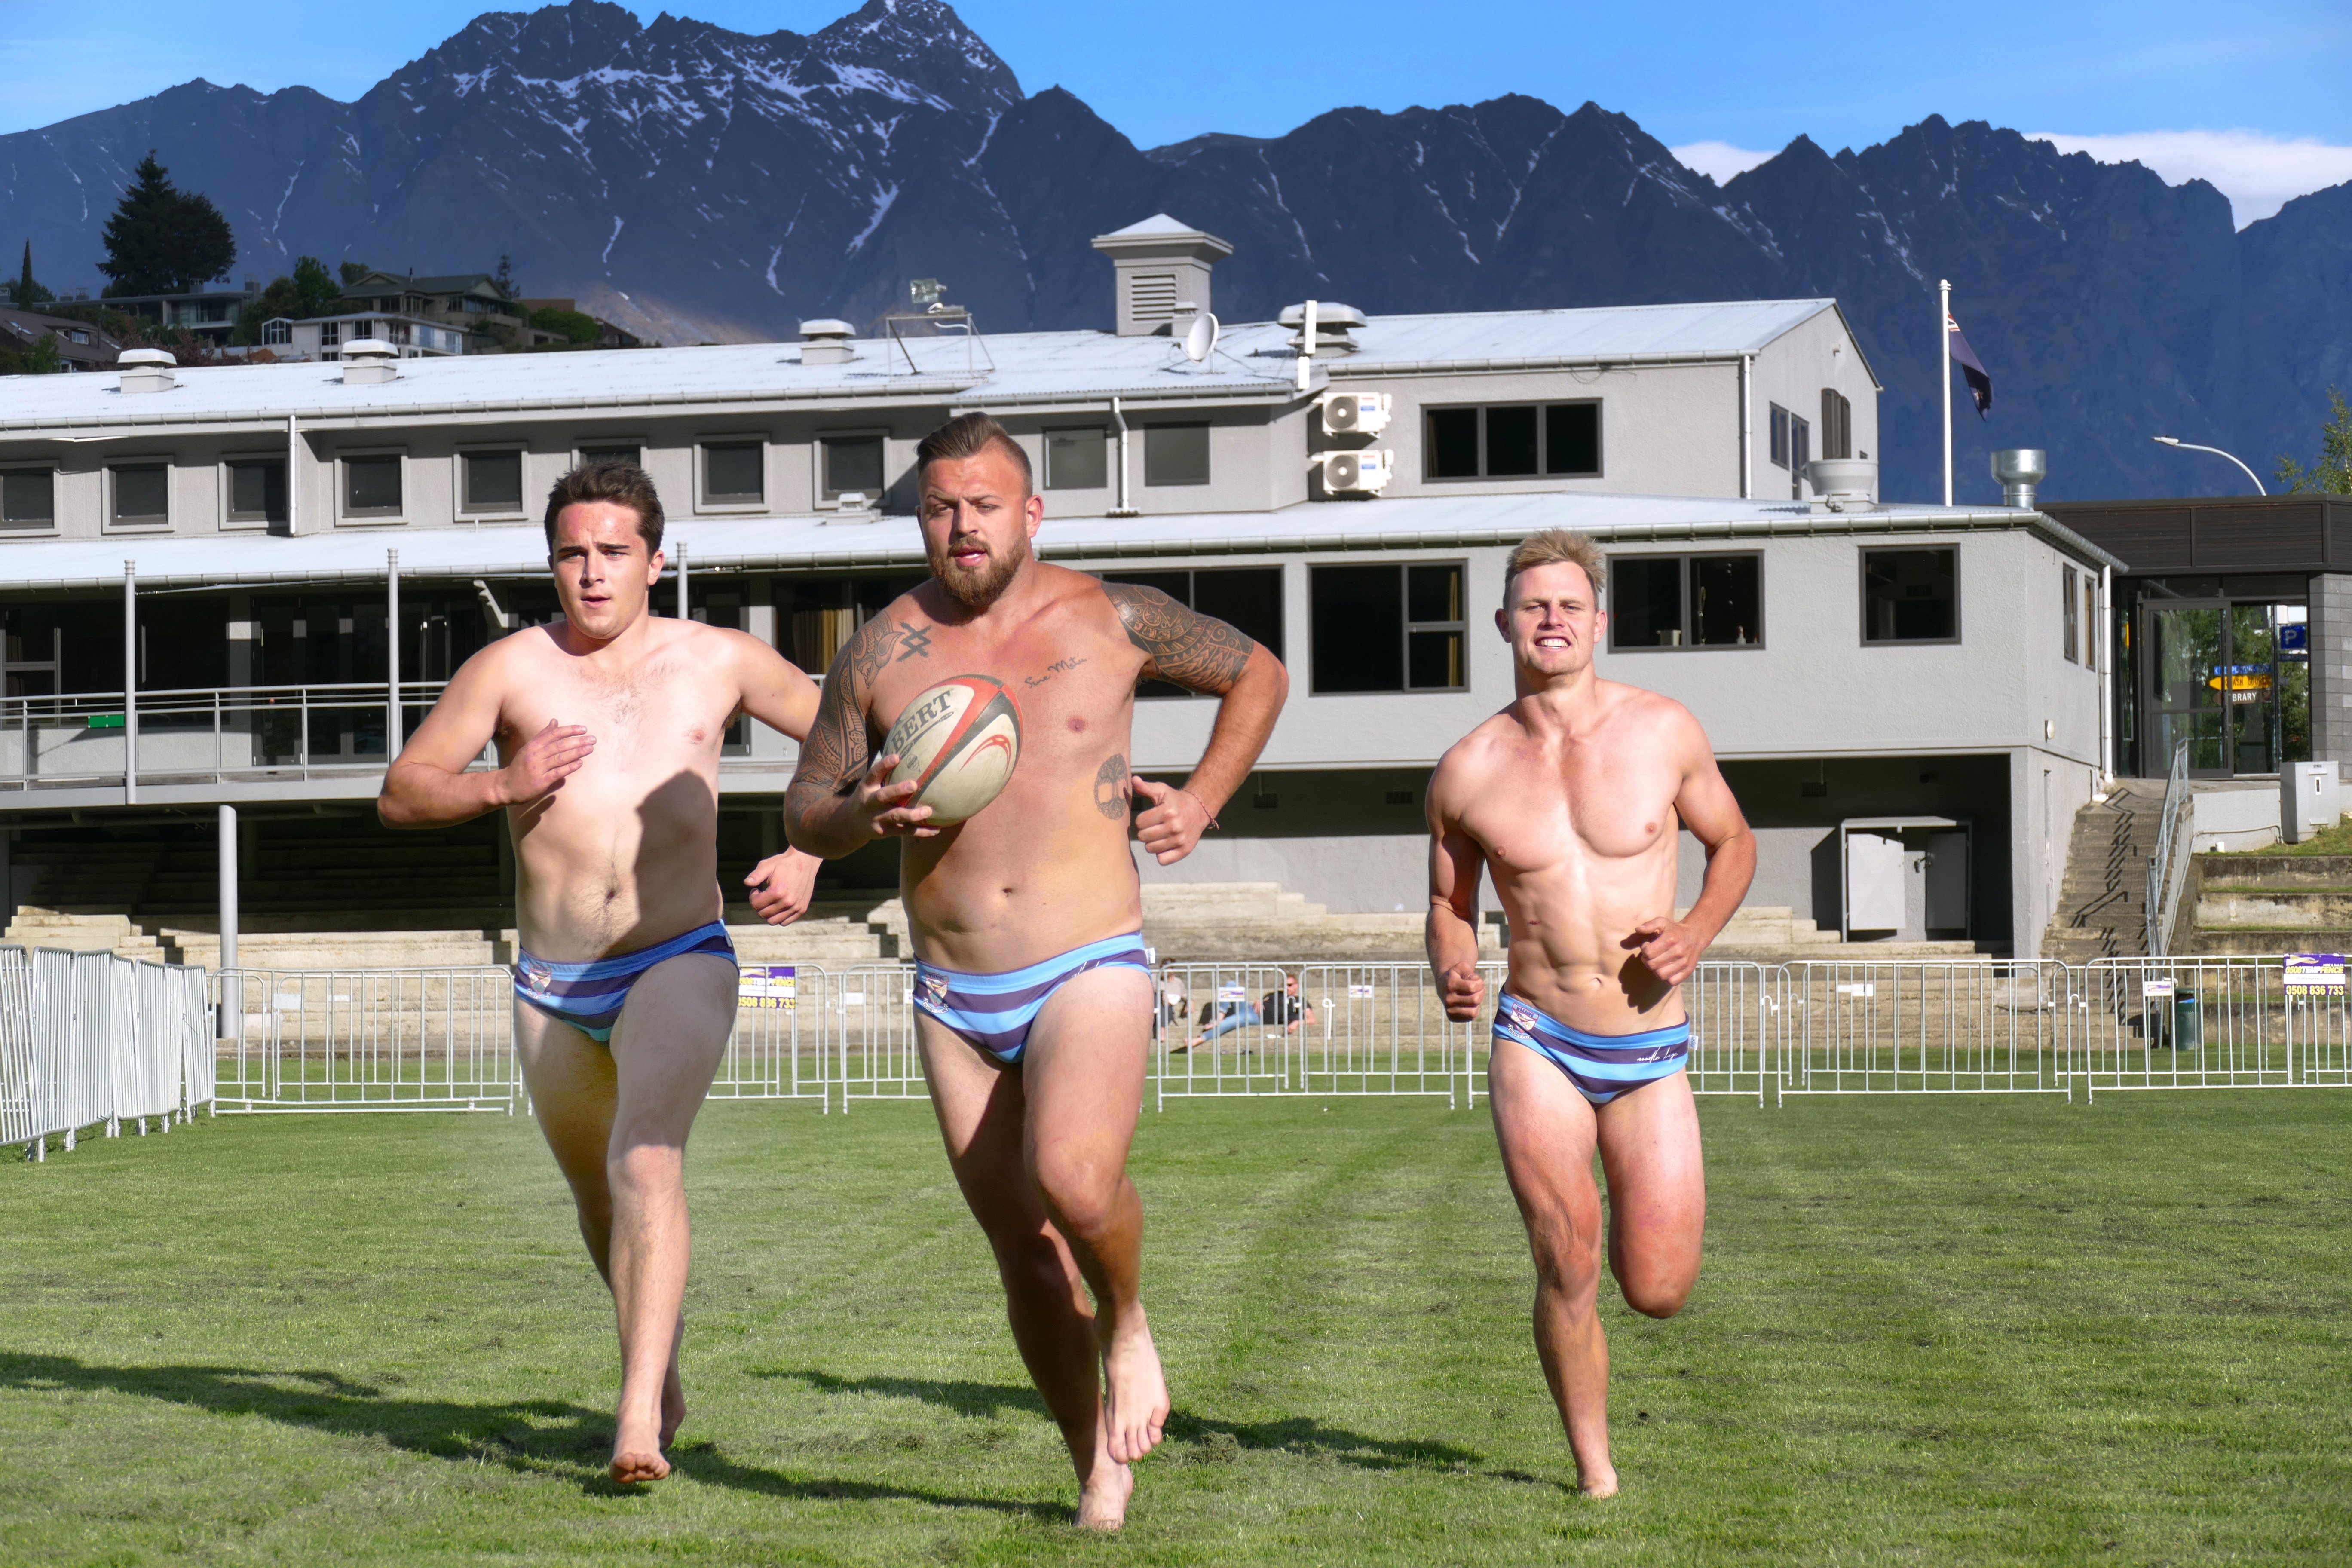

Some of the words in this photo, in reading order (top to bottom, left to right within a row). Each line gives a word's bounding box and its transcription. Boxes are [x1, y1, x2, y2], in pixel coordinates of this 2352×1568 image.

[2285, 629, 2297, 645] P
[2232, 692, 2257, 702] BRARY
[887, 690, 951, 753] BERT
[2286, 985, 2307, 995] 0508
[2309, 985, 2326, 995] 836
[2328, 985, 2344, 995] 733
